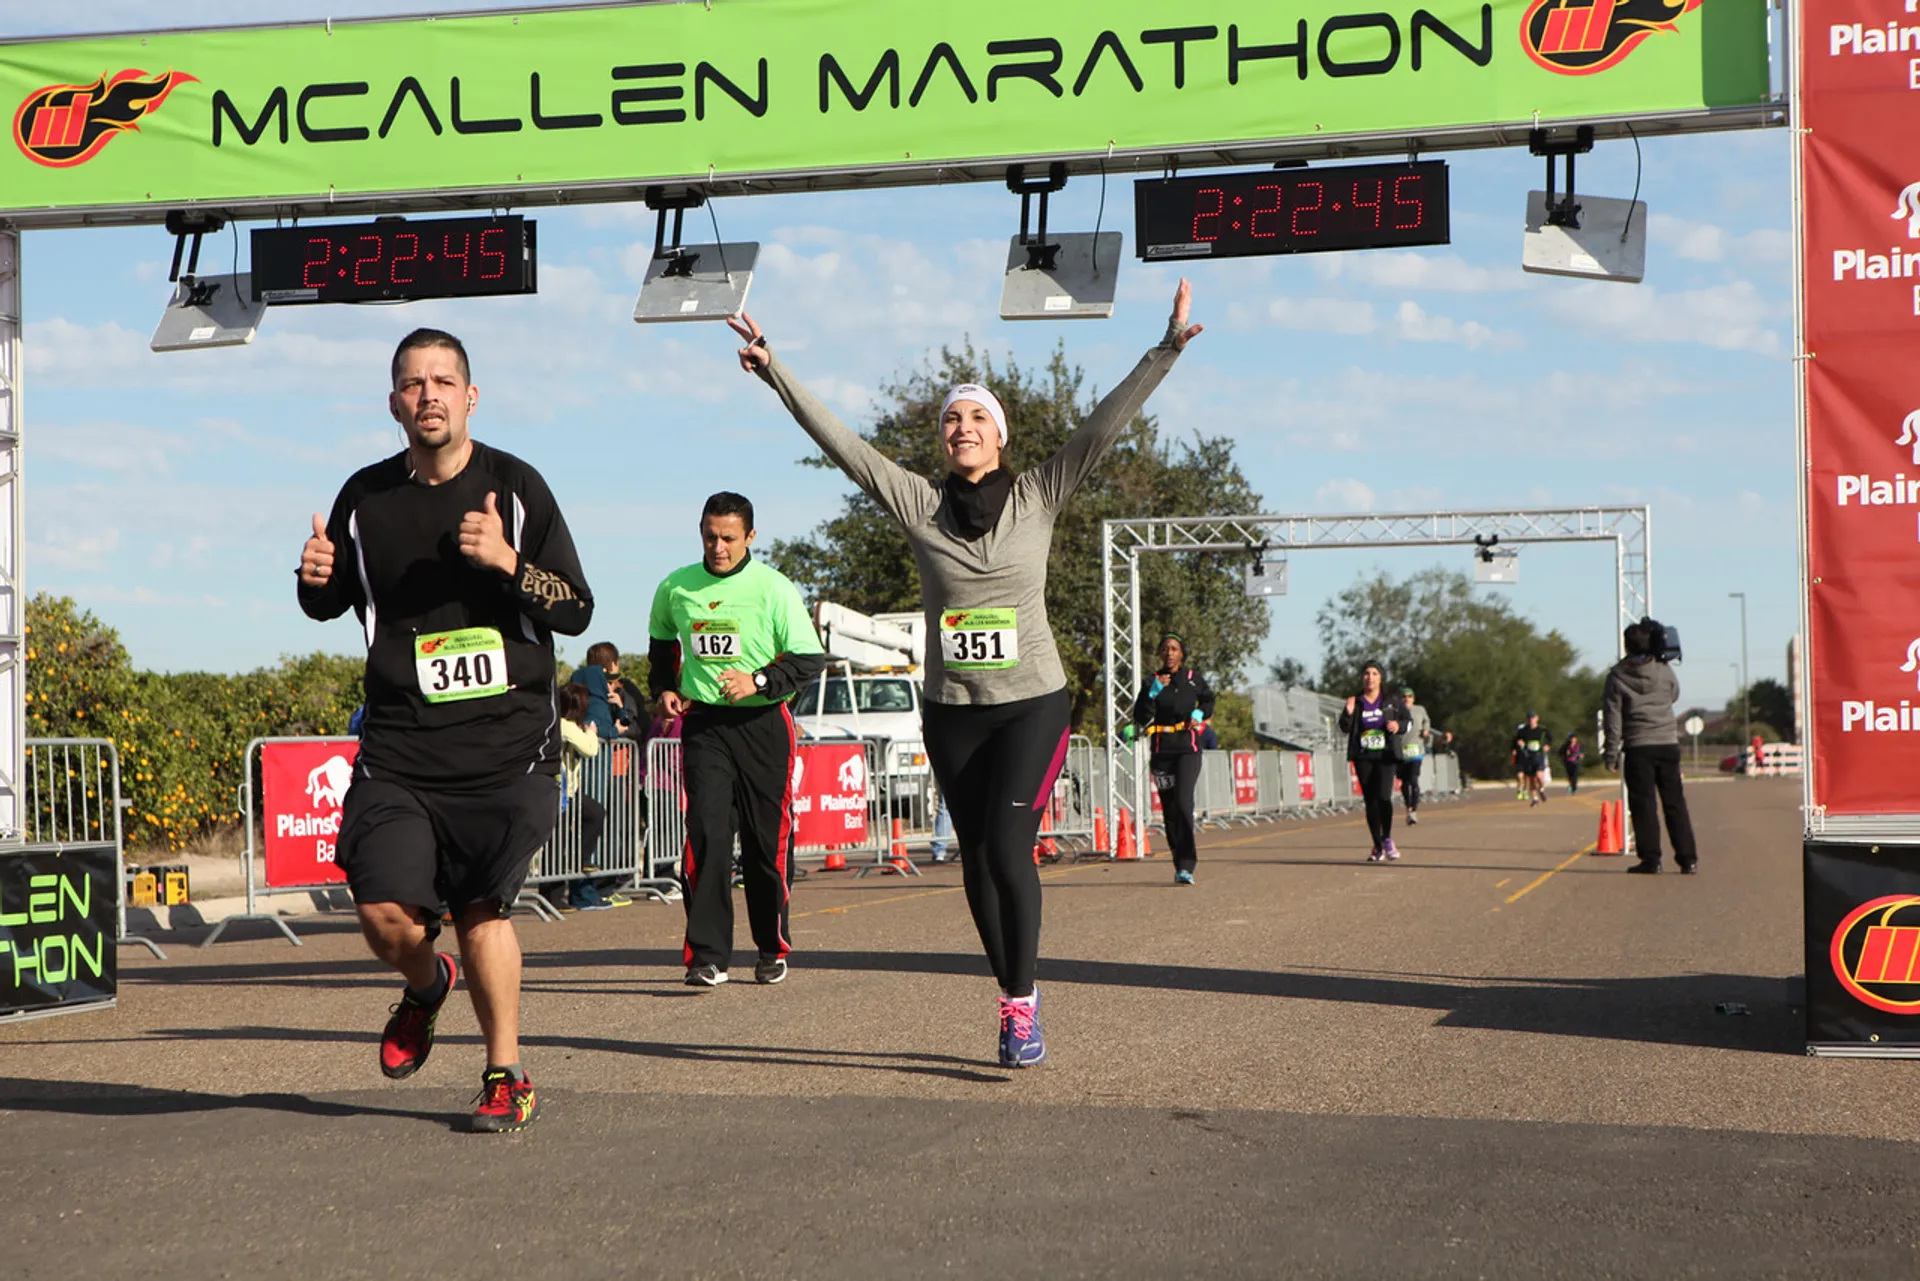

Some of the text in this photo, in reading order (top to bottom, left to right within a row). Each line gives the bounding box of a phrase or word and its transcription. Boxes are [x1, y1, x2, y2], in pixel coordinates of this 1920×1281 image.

[212, 2, 1493, 147] MCALLEN MARATHON
[699, 635, 733, 655] 162
[952, 631, 1005, 660] 351
[431, 653, 492, 691] 340
[844, 813, 863, 829] Bank
